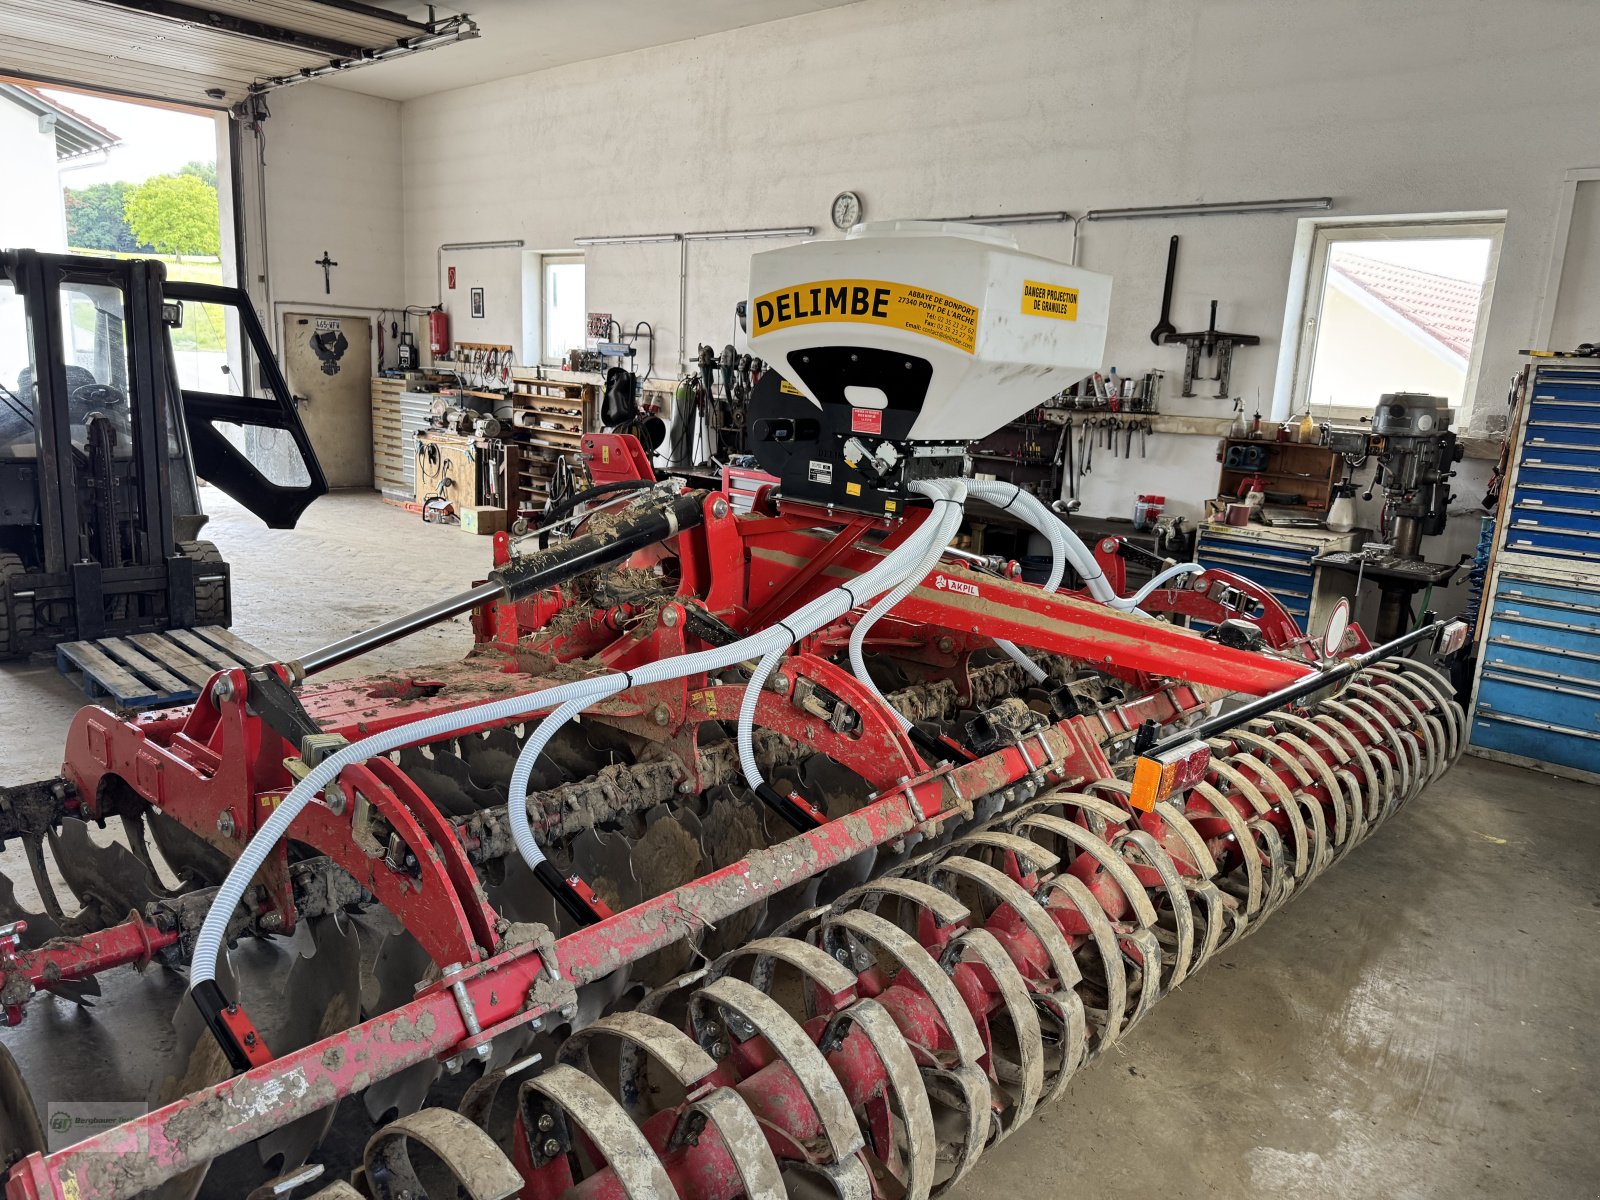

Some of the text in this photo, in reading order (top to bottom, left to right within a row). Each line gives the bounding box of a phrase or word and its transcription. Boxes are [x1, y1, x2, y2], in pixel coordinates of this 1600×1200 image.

[908, 290, 976, 316] ABBAYE DE BONPORT
[1024, 285, 1078, 304] DANGER PROJECTION
[755, 286, 891, 329] DELIMBE
[898, 296, 974, 325] 27340 PONT DE L'ARCHE
[1033, 299, 1067, 315] DE GRANULES
[925, 320, 935, 328] Fax:
[950, 582, 975, 594] AKPIL
